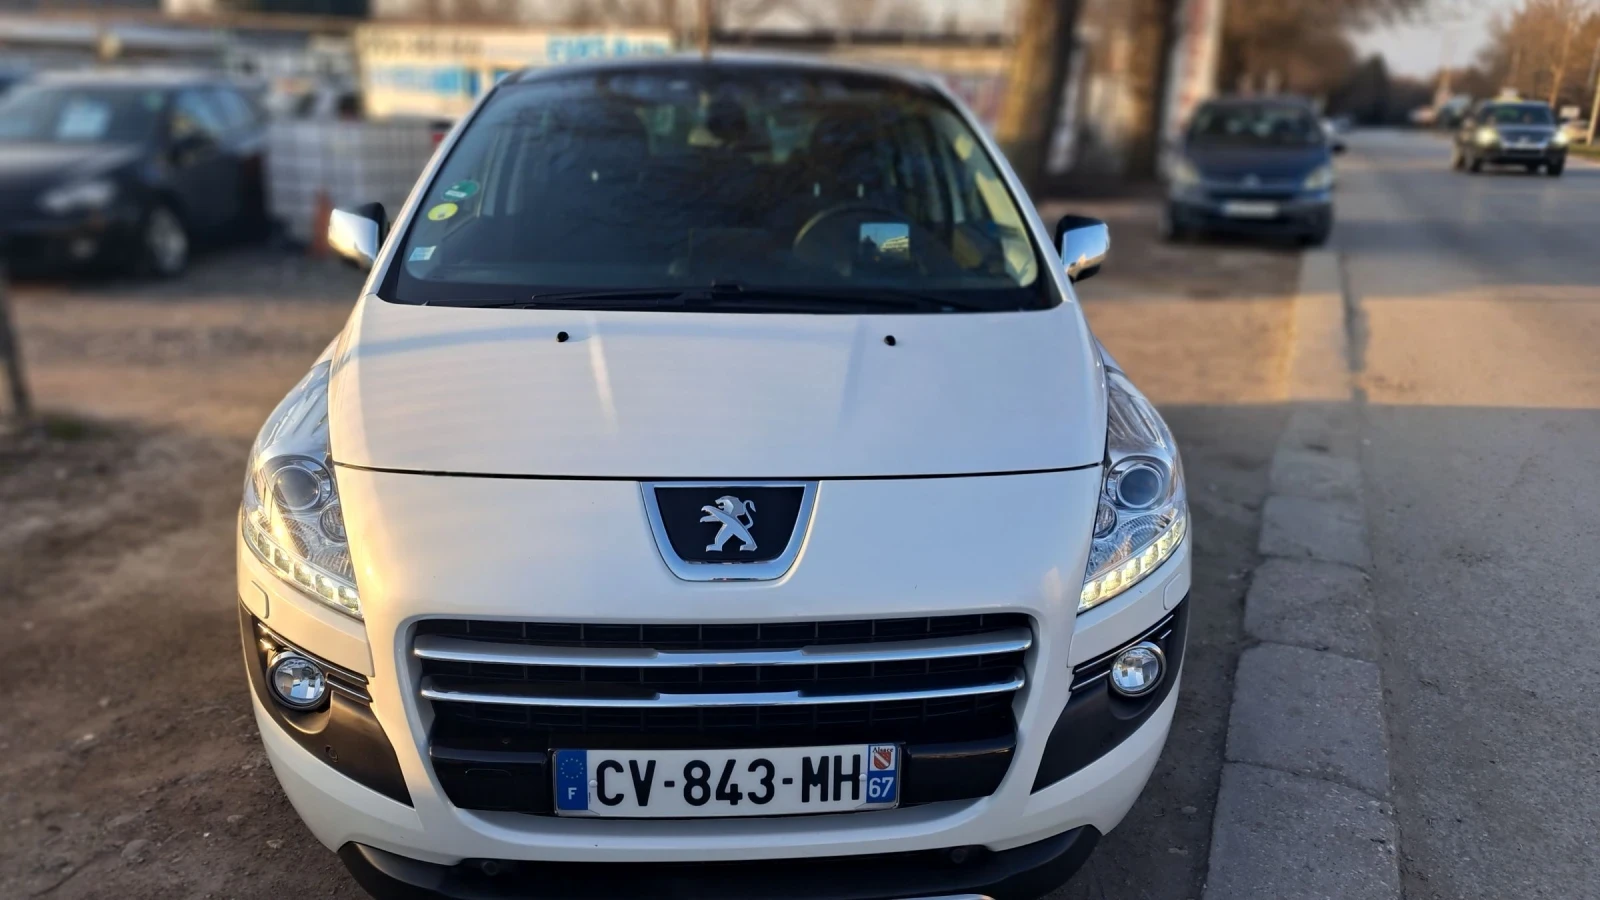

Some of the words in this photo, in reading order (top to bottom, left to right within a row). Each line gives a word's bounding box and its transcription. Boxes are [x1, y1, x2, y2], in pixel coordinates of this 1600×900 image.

[596, 754, 861, 807] CV-843-MH
[869, 776, 894, 798] 67
[568, 787, 577, 800] F
